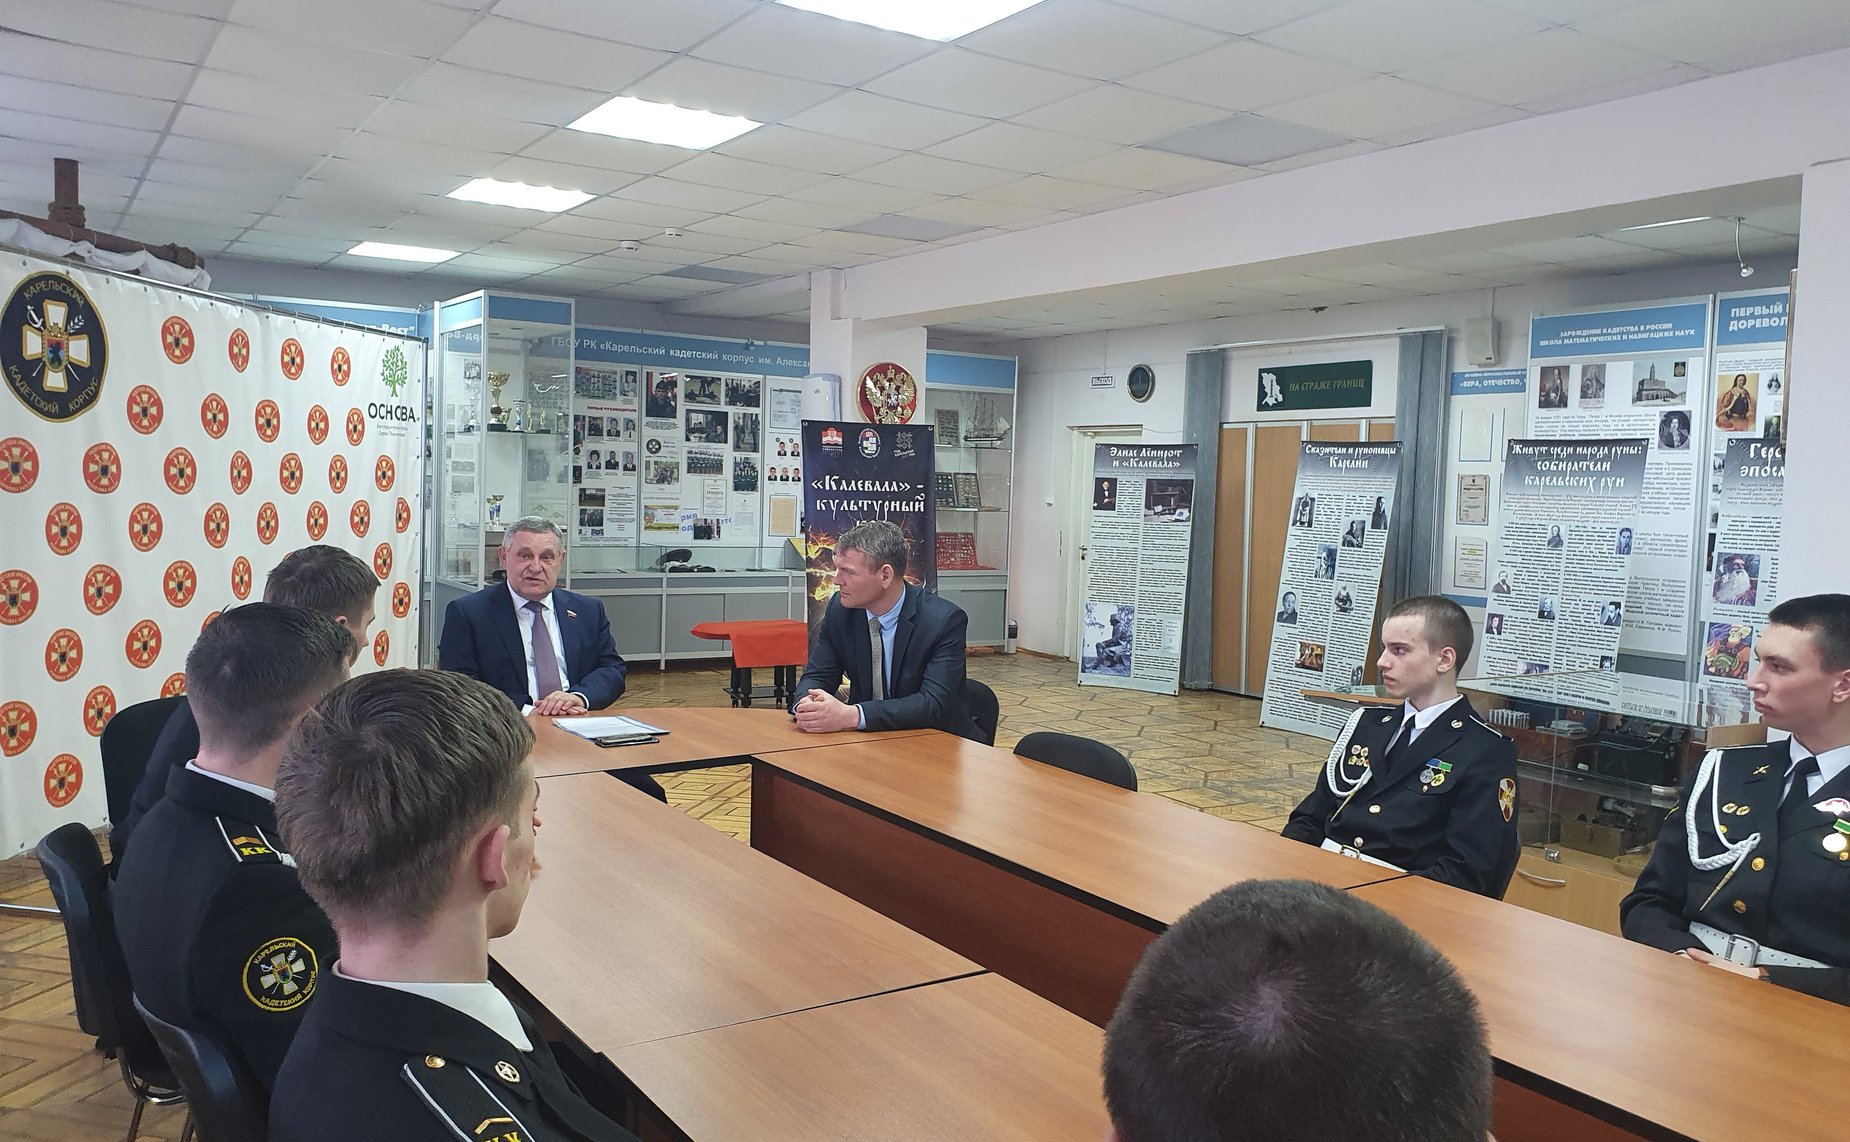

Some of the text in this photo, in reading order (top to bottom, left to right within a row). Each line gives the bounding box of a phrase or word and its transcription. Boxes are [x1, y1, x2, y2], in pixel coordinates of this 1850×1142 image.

[23, 280, 84, 307] КАРЕЛЬСКИЙ
[1731, 301, 1782, 317] ПЕРВЫЙ
[1602, 325, 1639, 334] КАДЕТСТВА
[1646, 322, 1673, 331] РОССИИ
[1728, 316, 1787, 332] ДОРЕВОЛ
[1563, 334, 1622, 345] МАТЕМАТИЧЕСКИХ
[1674, 328, 1696, 337] НАУК
[583, 339, 597, 349] РК
[600, 341, 666, 355] «Карельский
[669, 348, 718, 360] кадетский
[722, 353, 755, 364] корпус
[758, 357, 774, 365] им.
[9, 364, 59, 414] КАДЕТСКИЙ
[68, 376, 99, 413] КОРПУС
[1092, 377, 1112, 385] ВЫХОД
[1289, 378, 1365, 391] НА СТРАЖЕ ГРАНИЦ
[1483, 378, 1523, 387] ОТЕЧЕСТВО,
[1110, 447, 1183, 461] Элиас Лённрот
[1305, 444, 1397, 459] Сказители и рунопевцы
[1512, 444, 1642, 460] Живут среди народа руны:
[1122, 458, 1180, 468] «Калевала»
[1329, 457, 1369, 474] Карелии
[1536, 461, 1611, 477] собиратели
[811, 475, 910, 492] «Калевала»
[1524, 475, 1625, 495] карельских рун
[816, 493, 925, 521] культурный
[240, 846, 272, 856] КК
[254, 941, 296, 965] КАРЕЛЬСКИЙ
[260, 970, 316, 1007] КАДЕТСКИЙ КОРПУС
